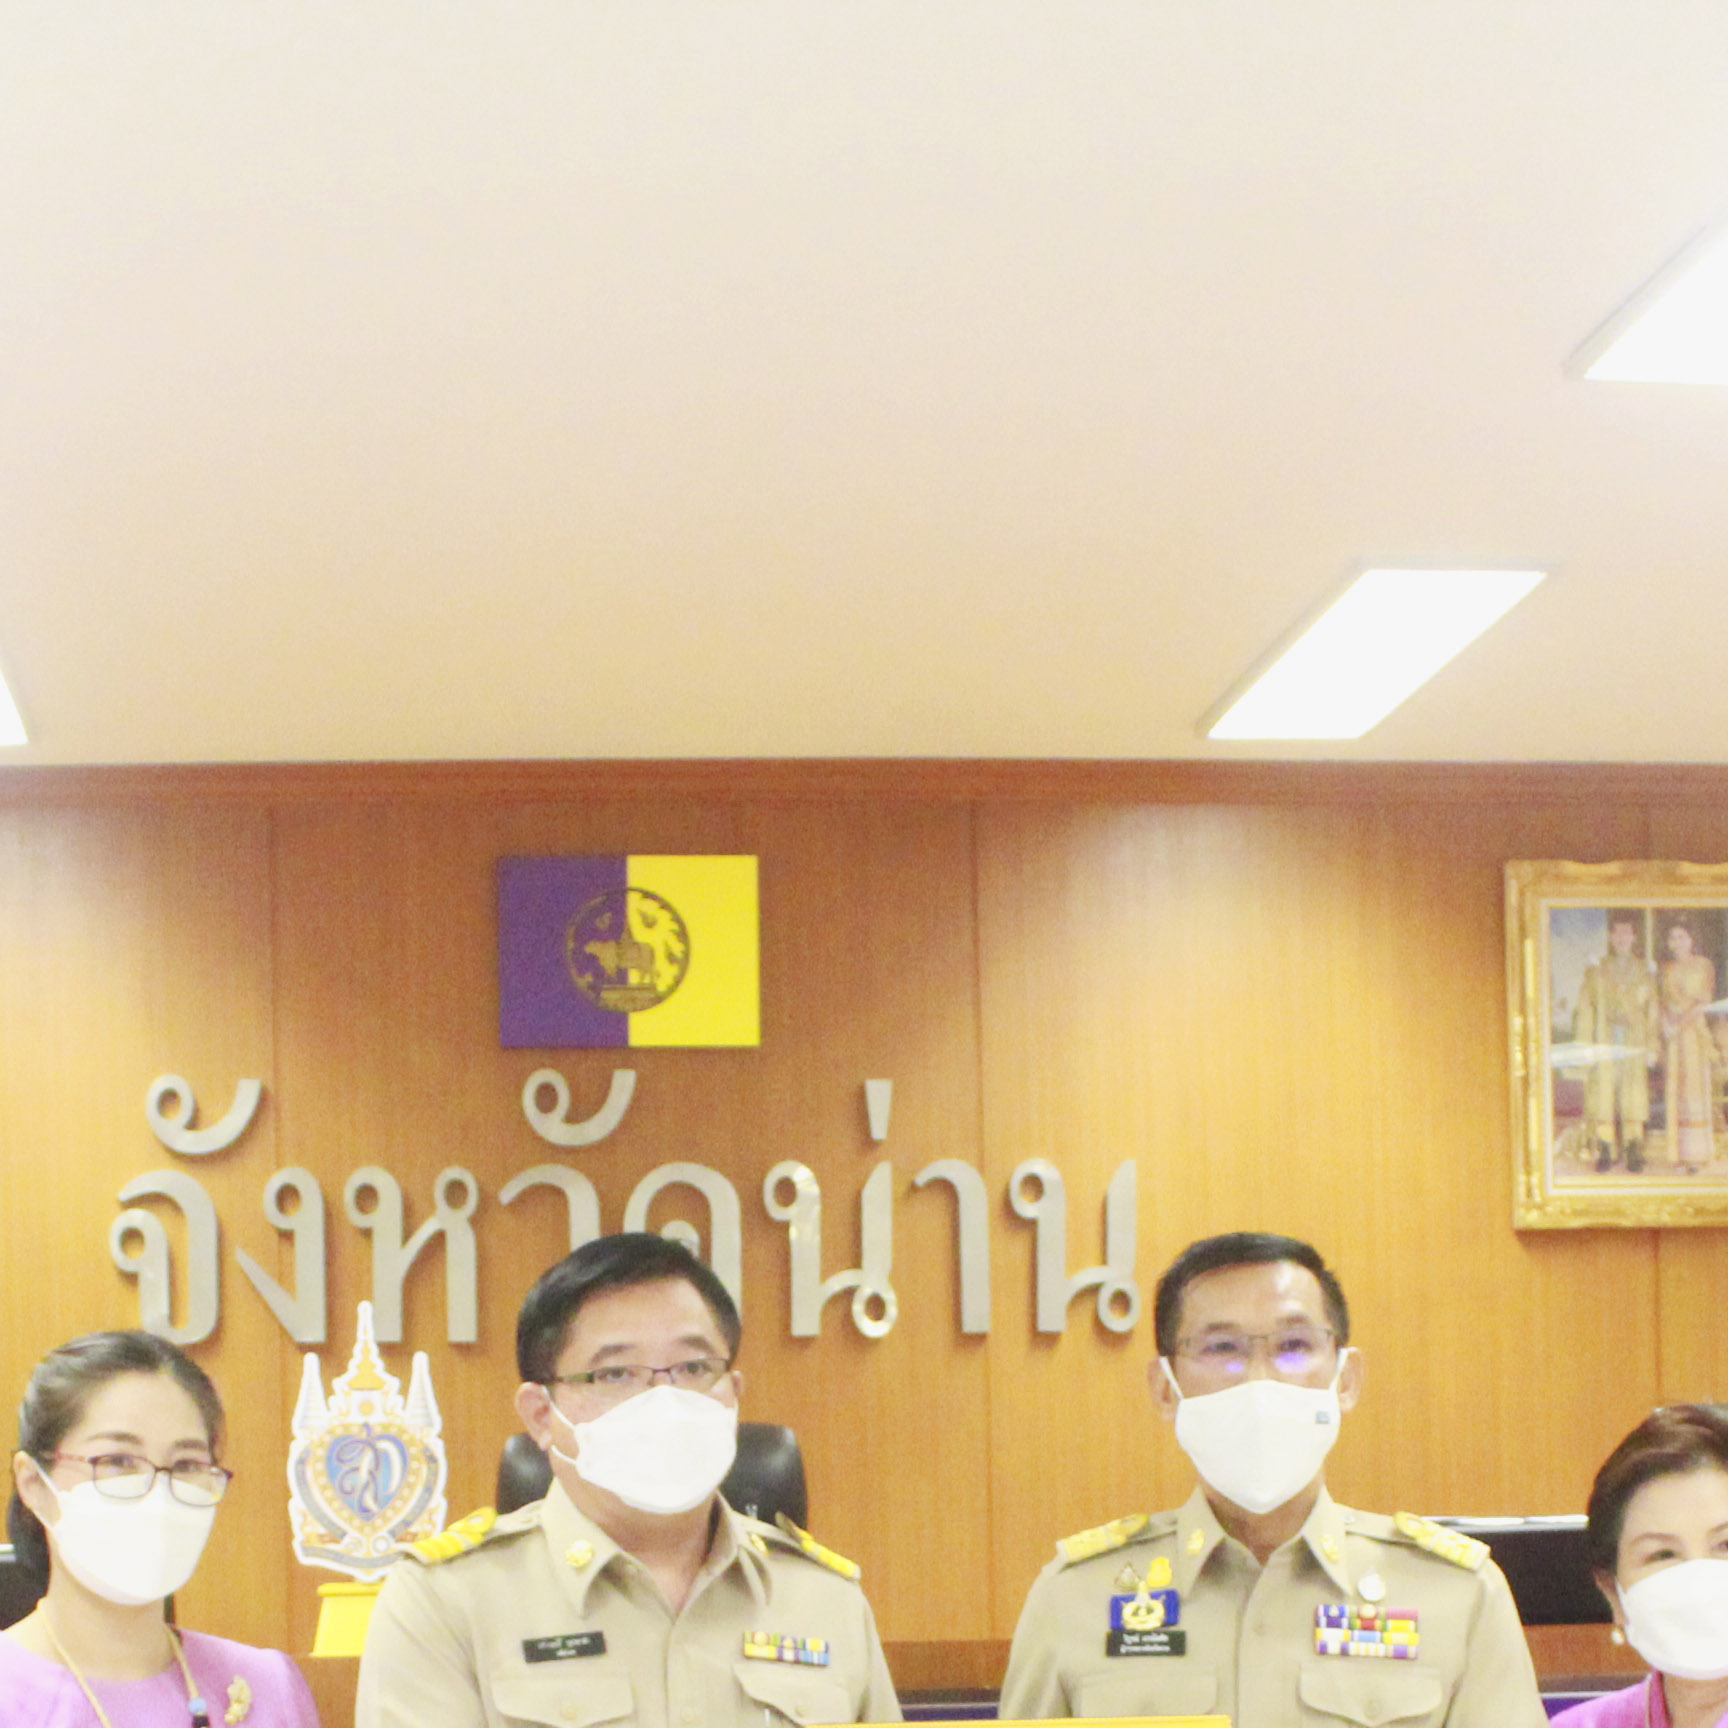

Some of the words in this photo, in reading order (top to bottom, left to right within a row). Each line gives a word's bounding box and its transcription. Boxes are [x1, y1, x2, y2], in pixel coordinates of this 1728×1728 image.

[109, 1069, 1141, 1345] จังหวัดน่าน
